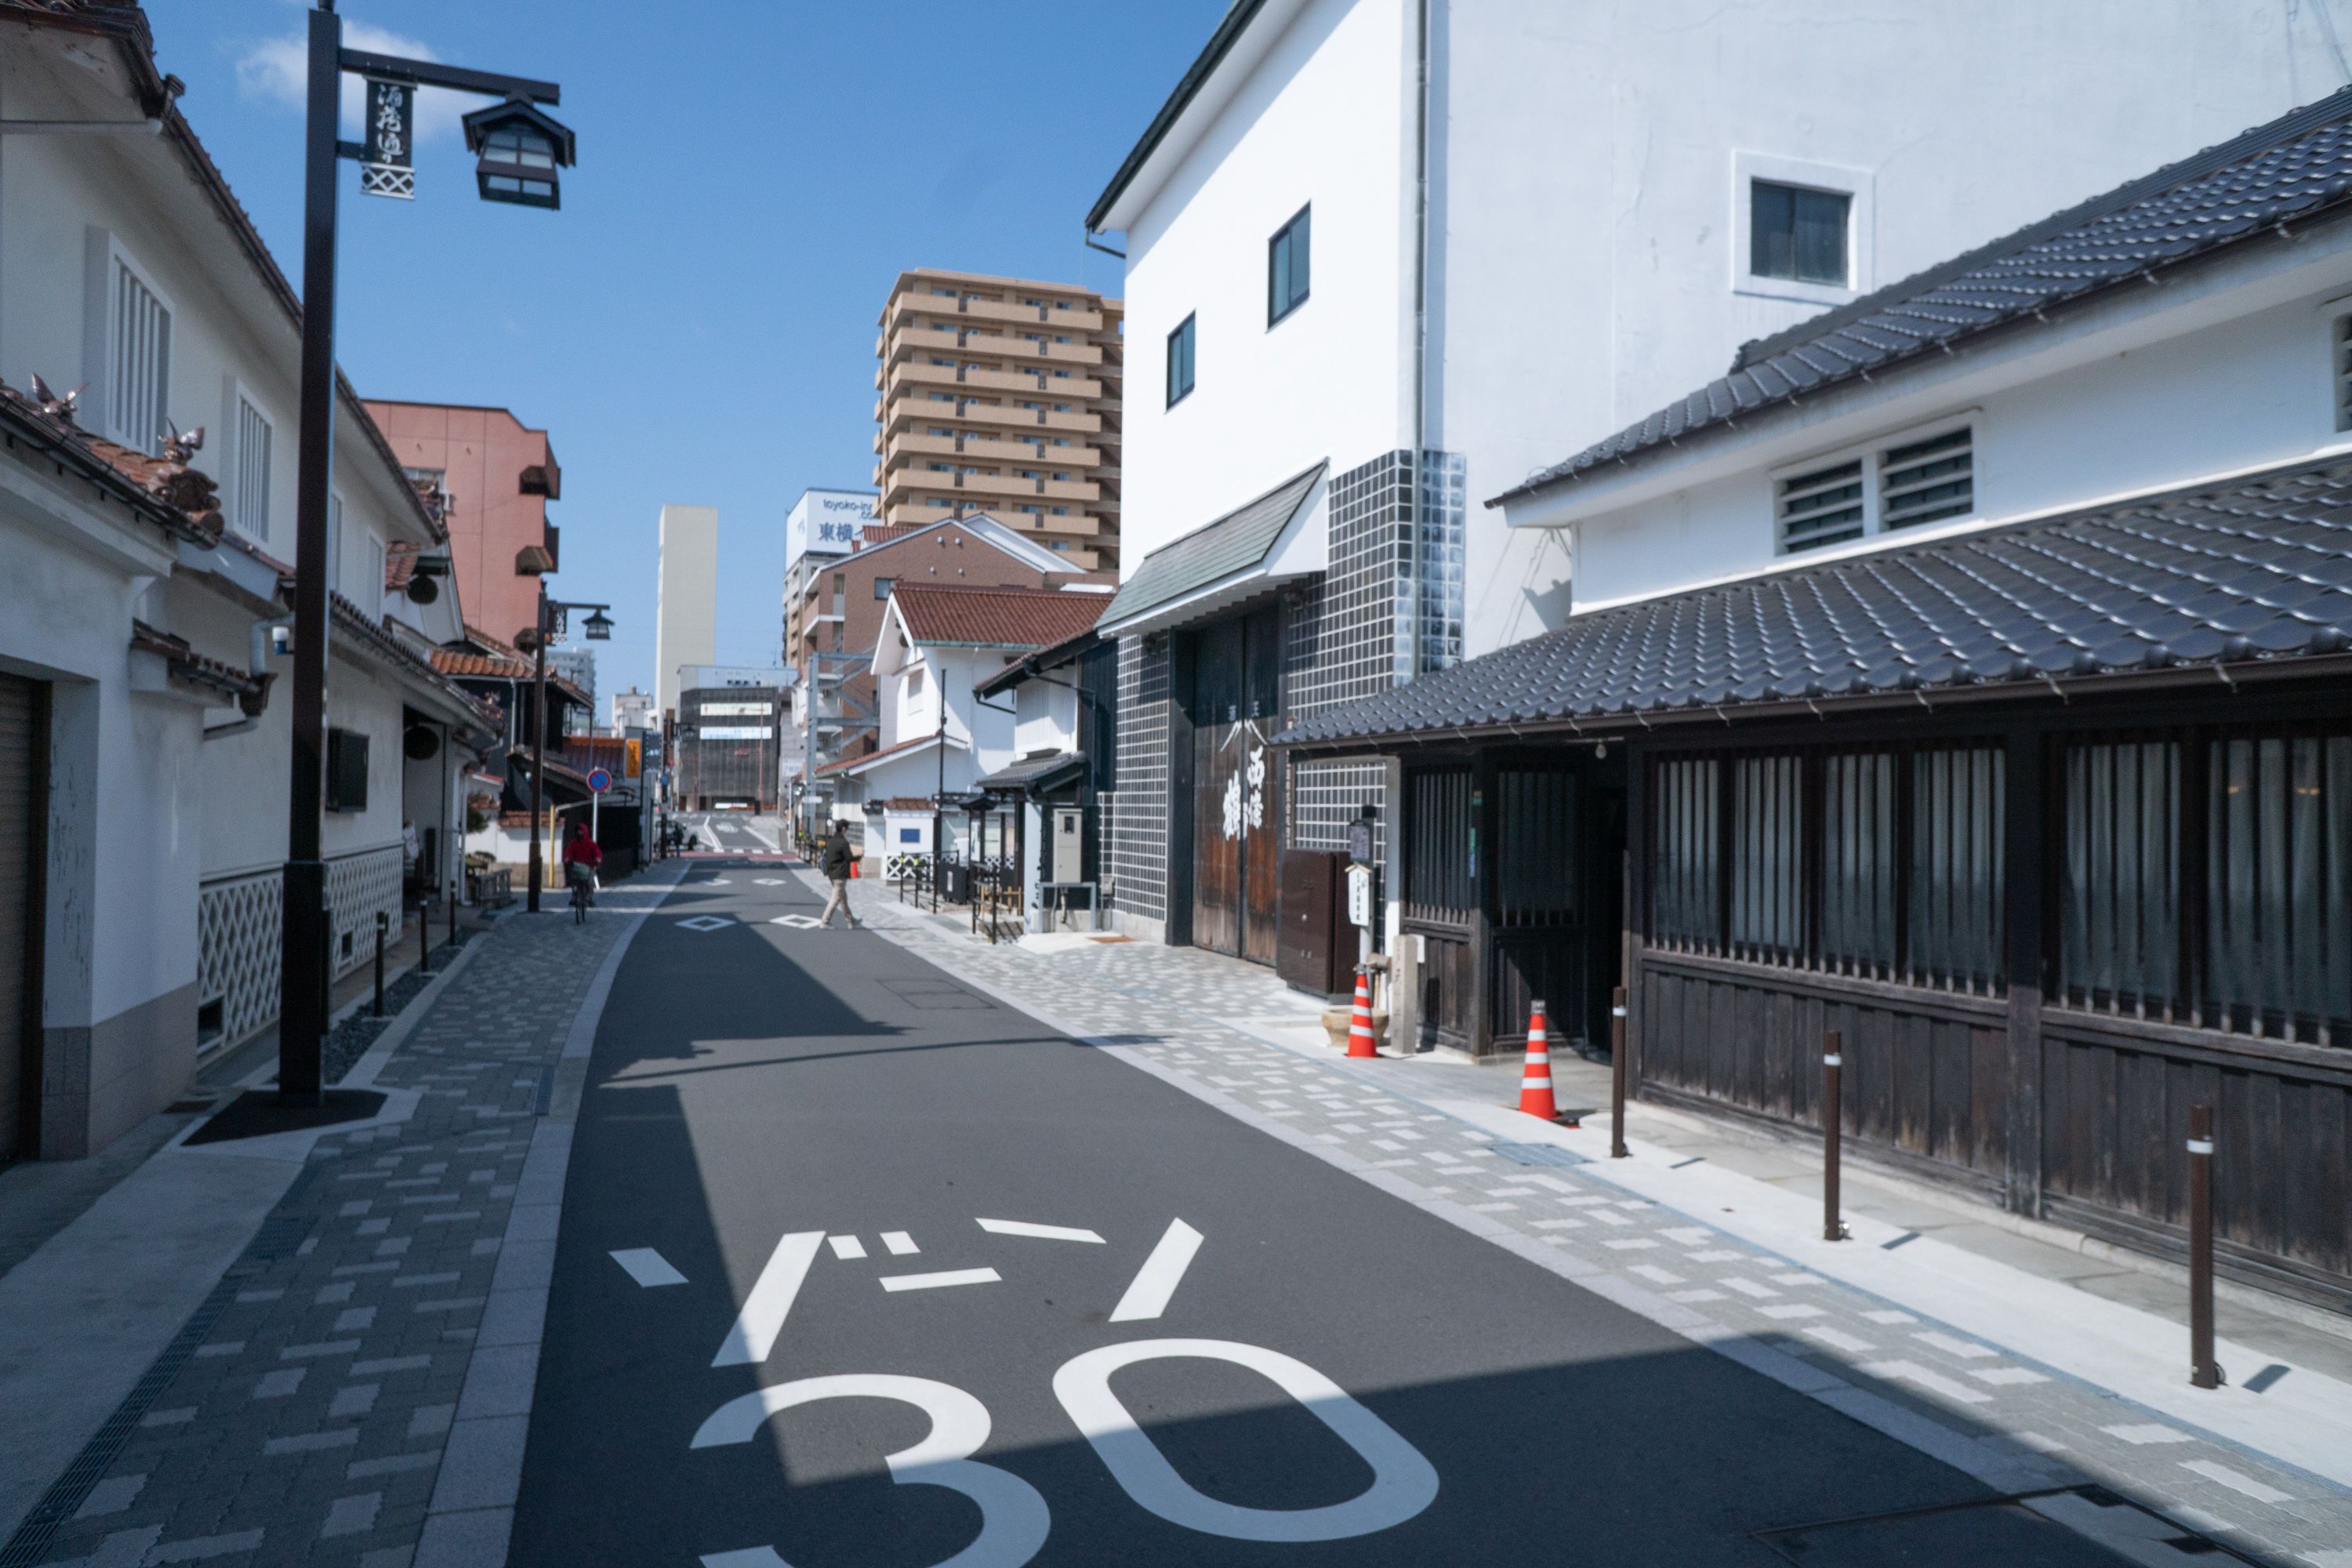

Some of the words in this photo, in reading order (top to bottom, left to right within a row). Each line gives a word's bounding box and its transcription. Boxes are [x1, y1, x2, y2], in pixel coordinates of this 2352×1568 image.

[376, 84, 404, 164] 酒蔵通り
[818, 522, 856, 542] 東横
[859, 511, 873, 520] .co
[609, 1217, 1204, 1367] ゾーン
[689, 1338, 1439, 1568] 30
